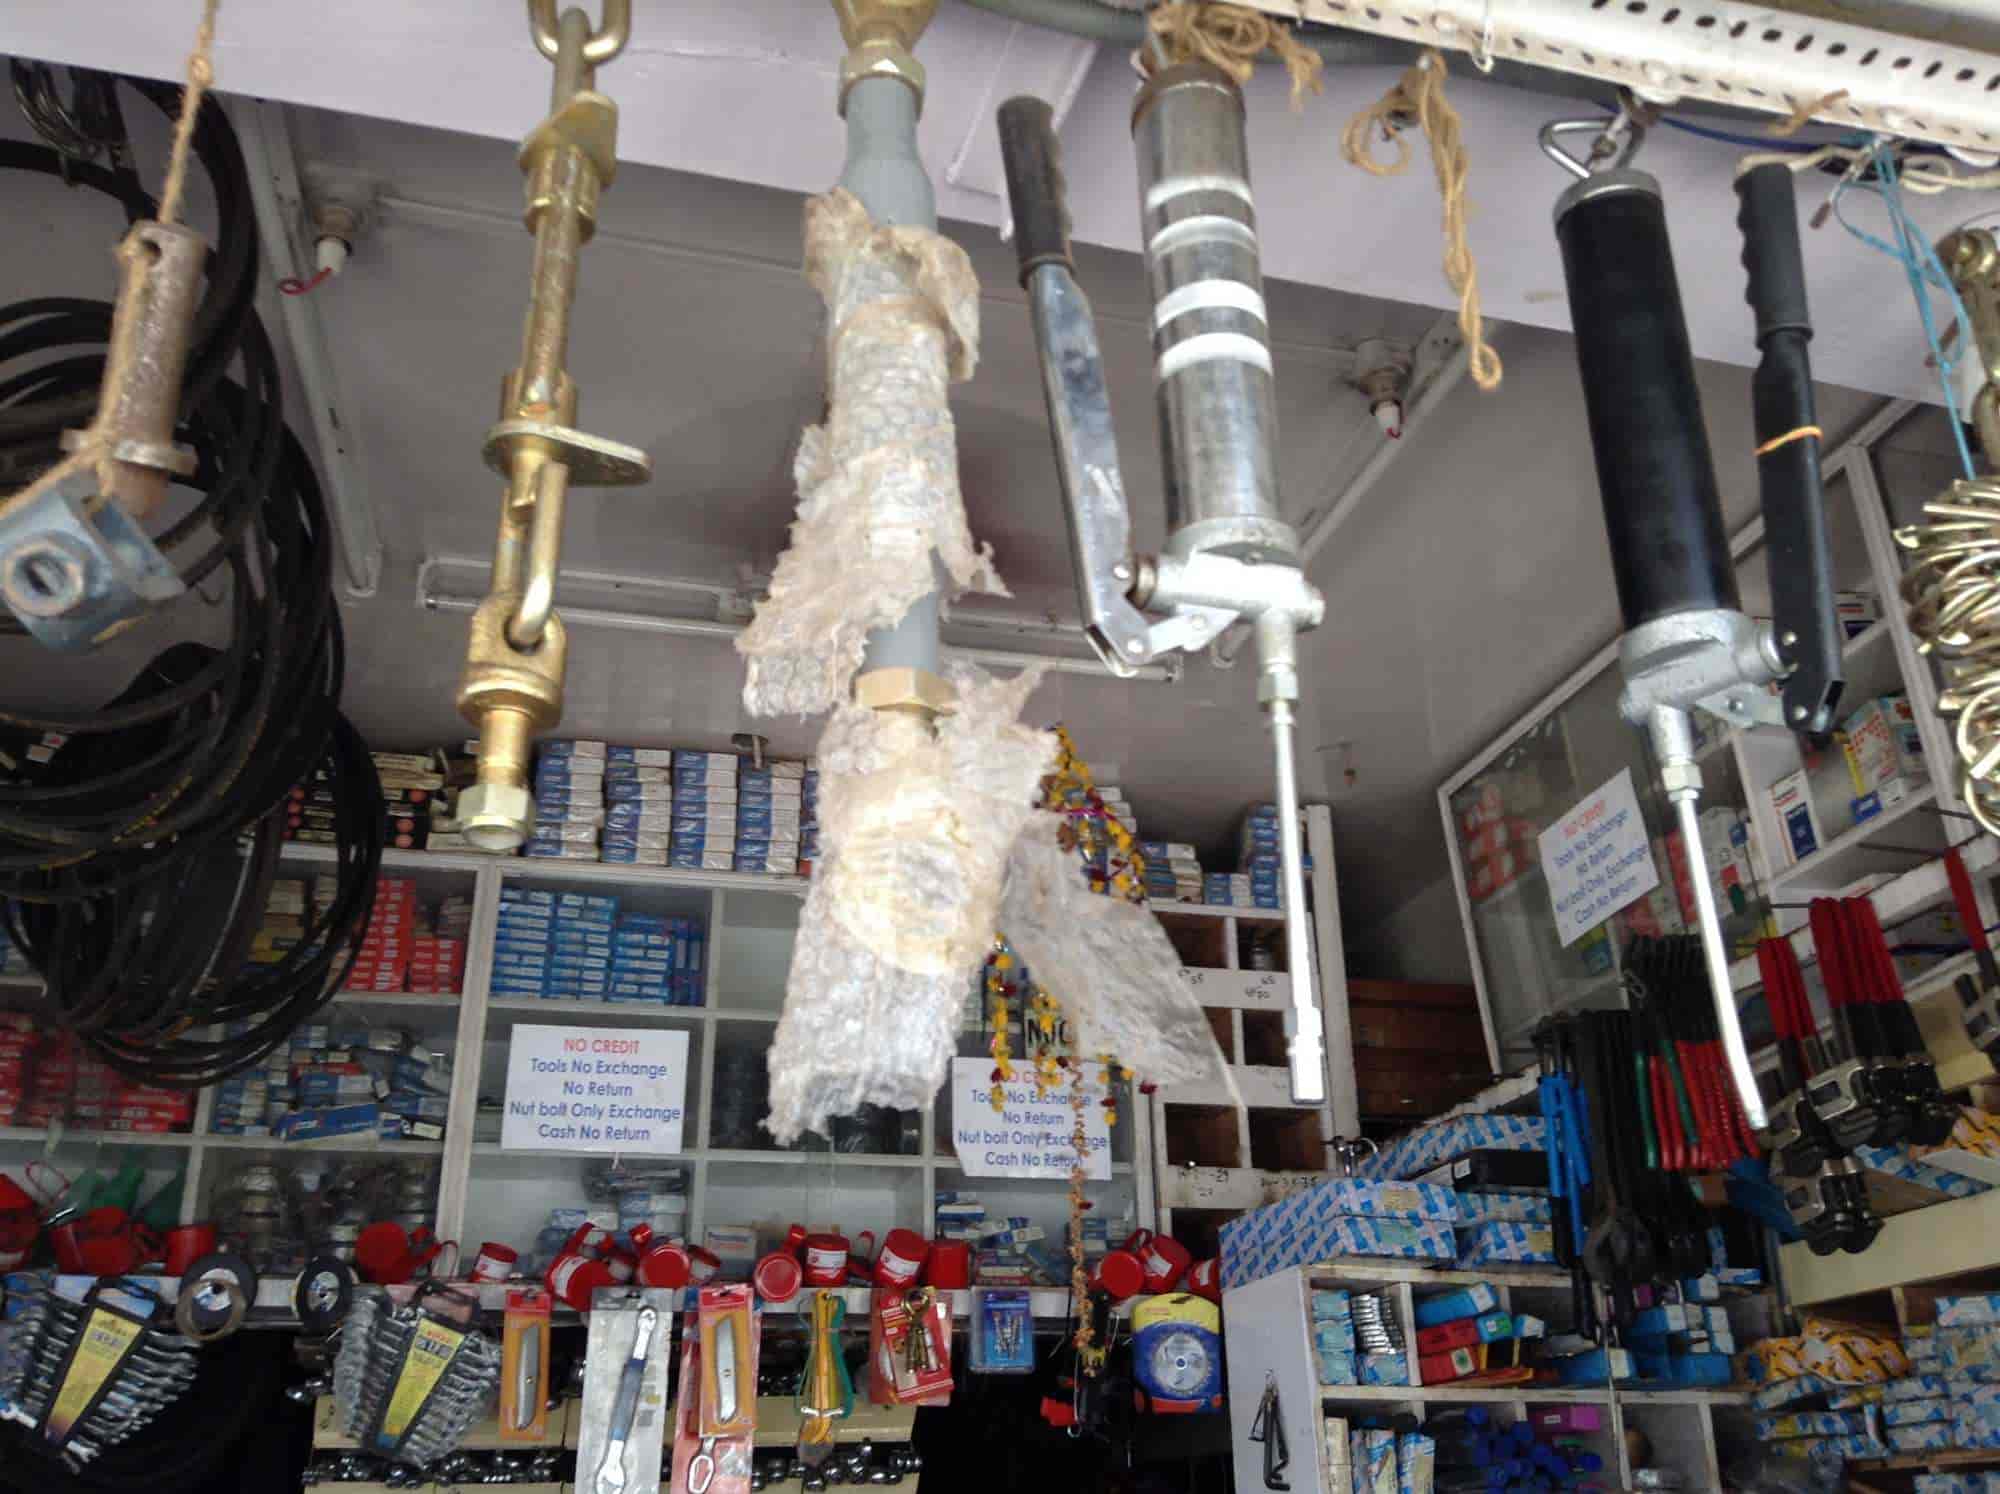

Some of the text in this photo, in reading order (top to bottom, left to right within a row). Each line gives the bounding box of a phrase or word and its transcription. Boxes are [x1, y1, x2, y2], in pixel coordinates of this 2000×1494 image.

[563, 1038, 640, 1054] NO CREDIT
[531, 1058, 668, 1079] Tools No Exchange
[562, 1081, 633, 1097] No Return
[1008, 1090, 1026, 1104] No
[509, 1101, 681, 1122] Nut bolt Only Exchange
[1003, 1112, 1064, 1126] No Return
[538, 1124, 650, 1141] Cash No Return
[959, 1129, 980, 1144] Nut
[1012, 1131, 1041, 1149] Only
[985, 1151, 1018, 1167] Cash
[1022, 1153, 1040, 1167] No
